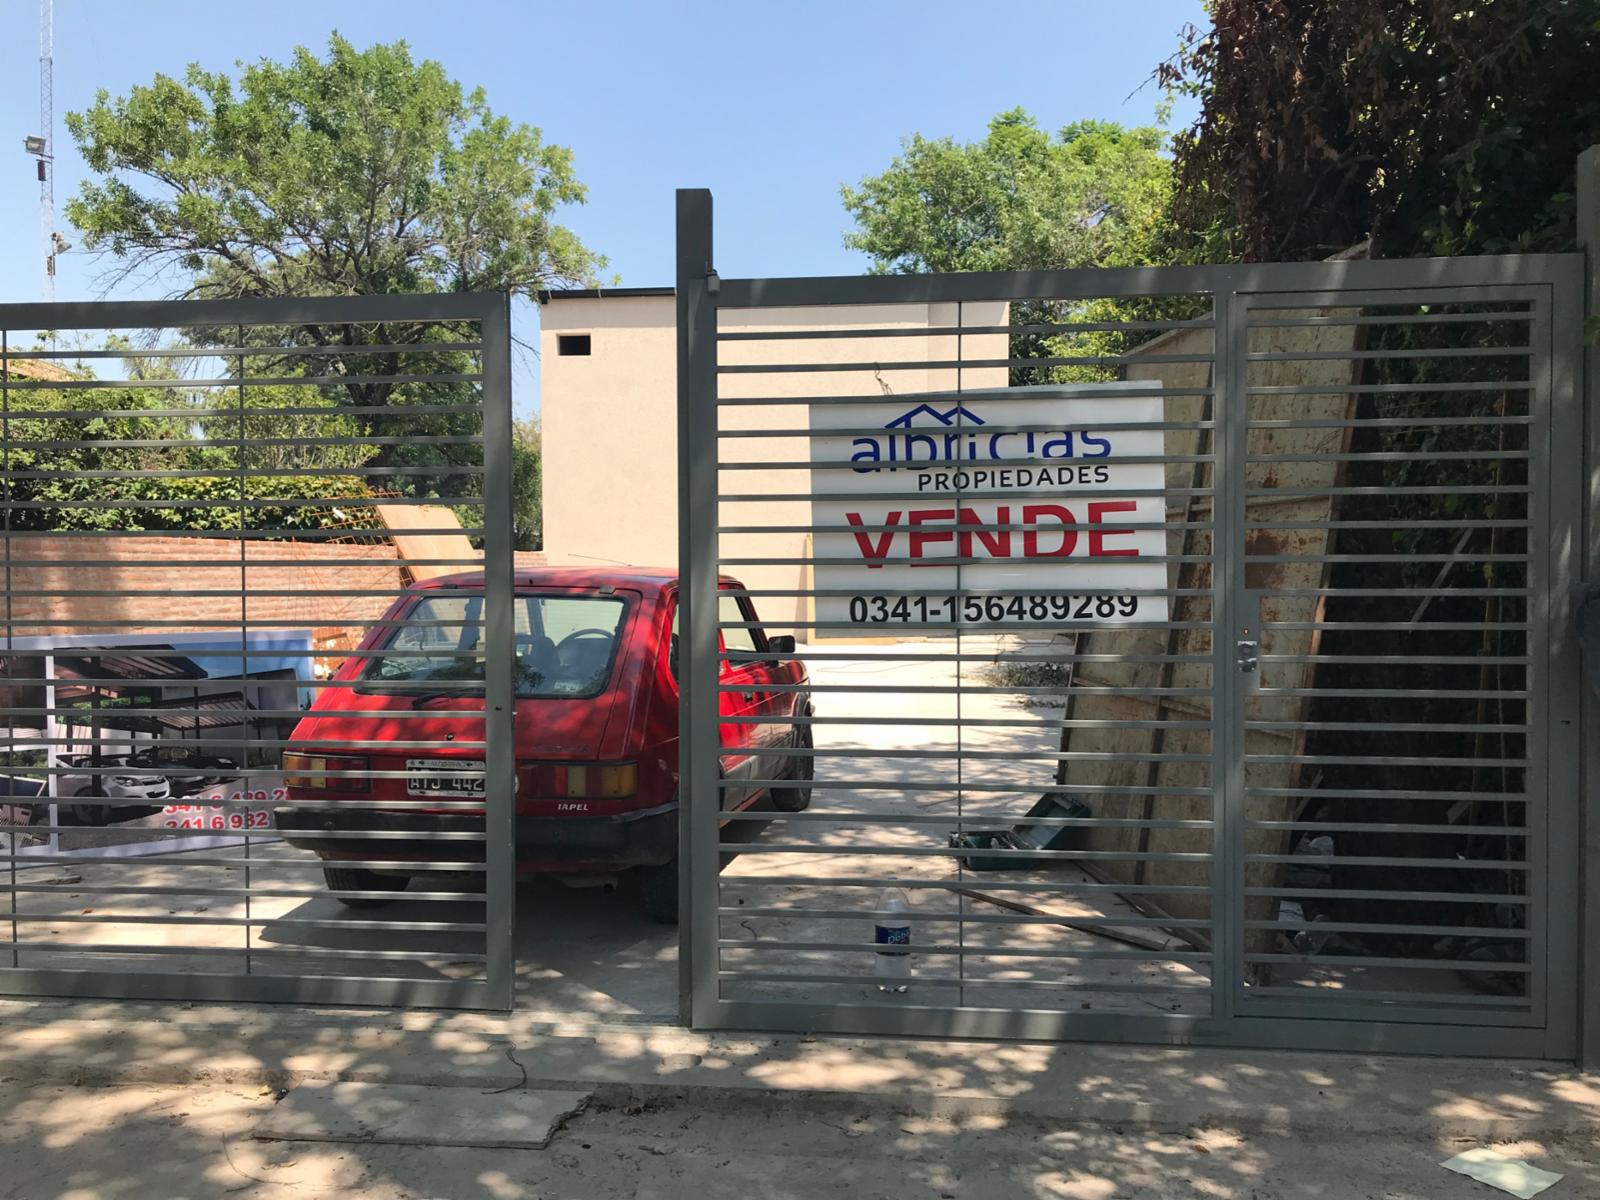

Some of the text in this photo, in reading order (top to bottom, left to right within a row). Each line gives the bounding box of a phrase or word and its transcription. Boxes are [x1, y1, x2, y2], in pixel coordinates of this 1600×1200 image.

[918, 465, 1109, 491] PROPIEDADES
[846, 501, 1140, 569] VENDE
[850, 595, 1138, 623] 0341-156489289
[211, 816, 225, 830] 6
